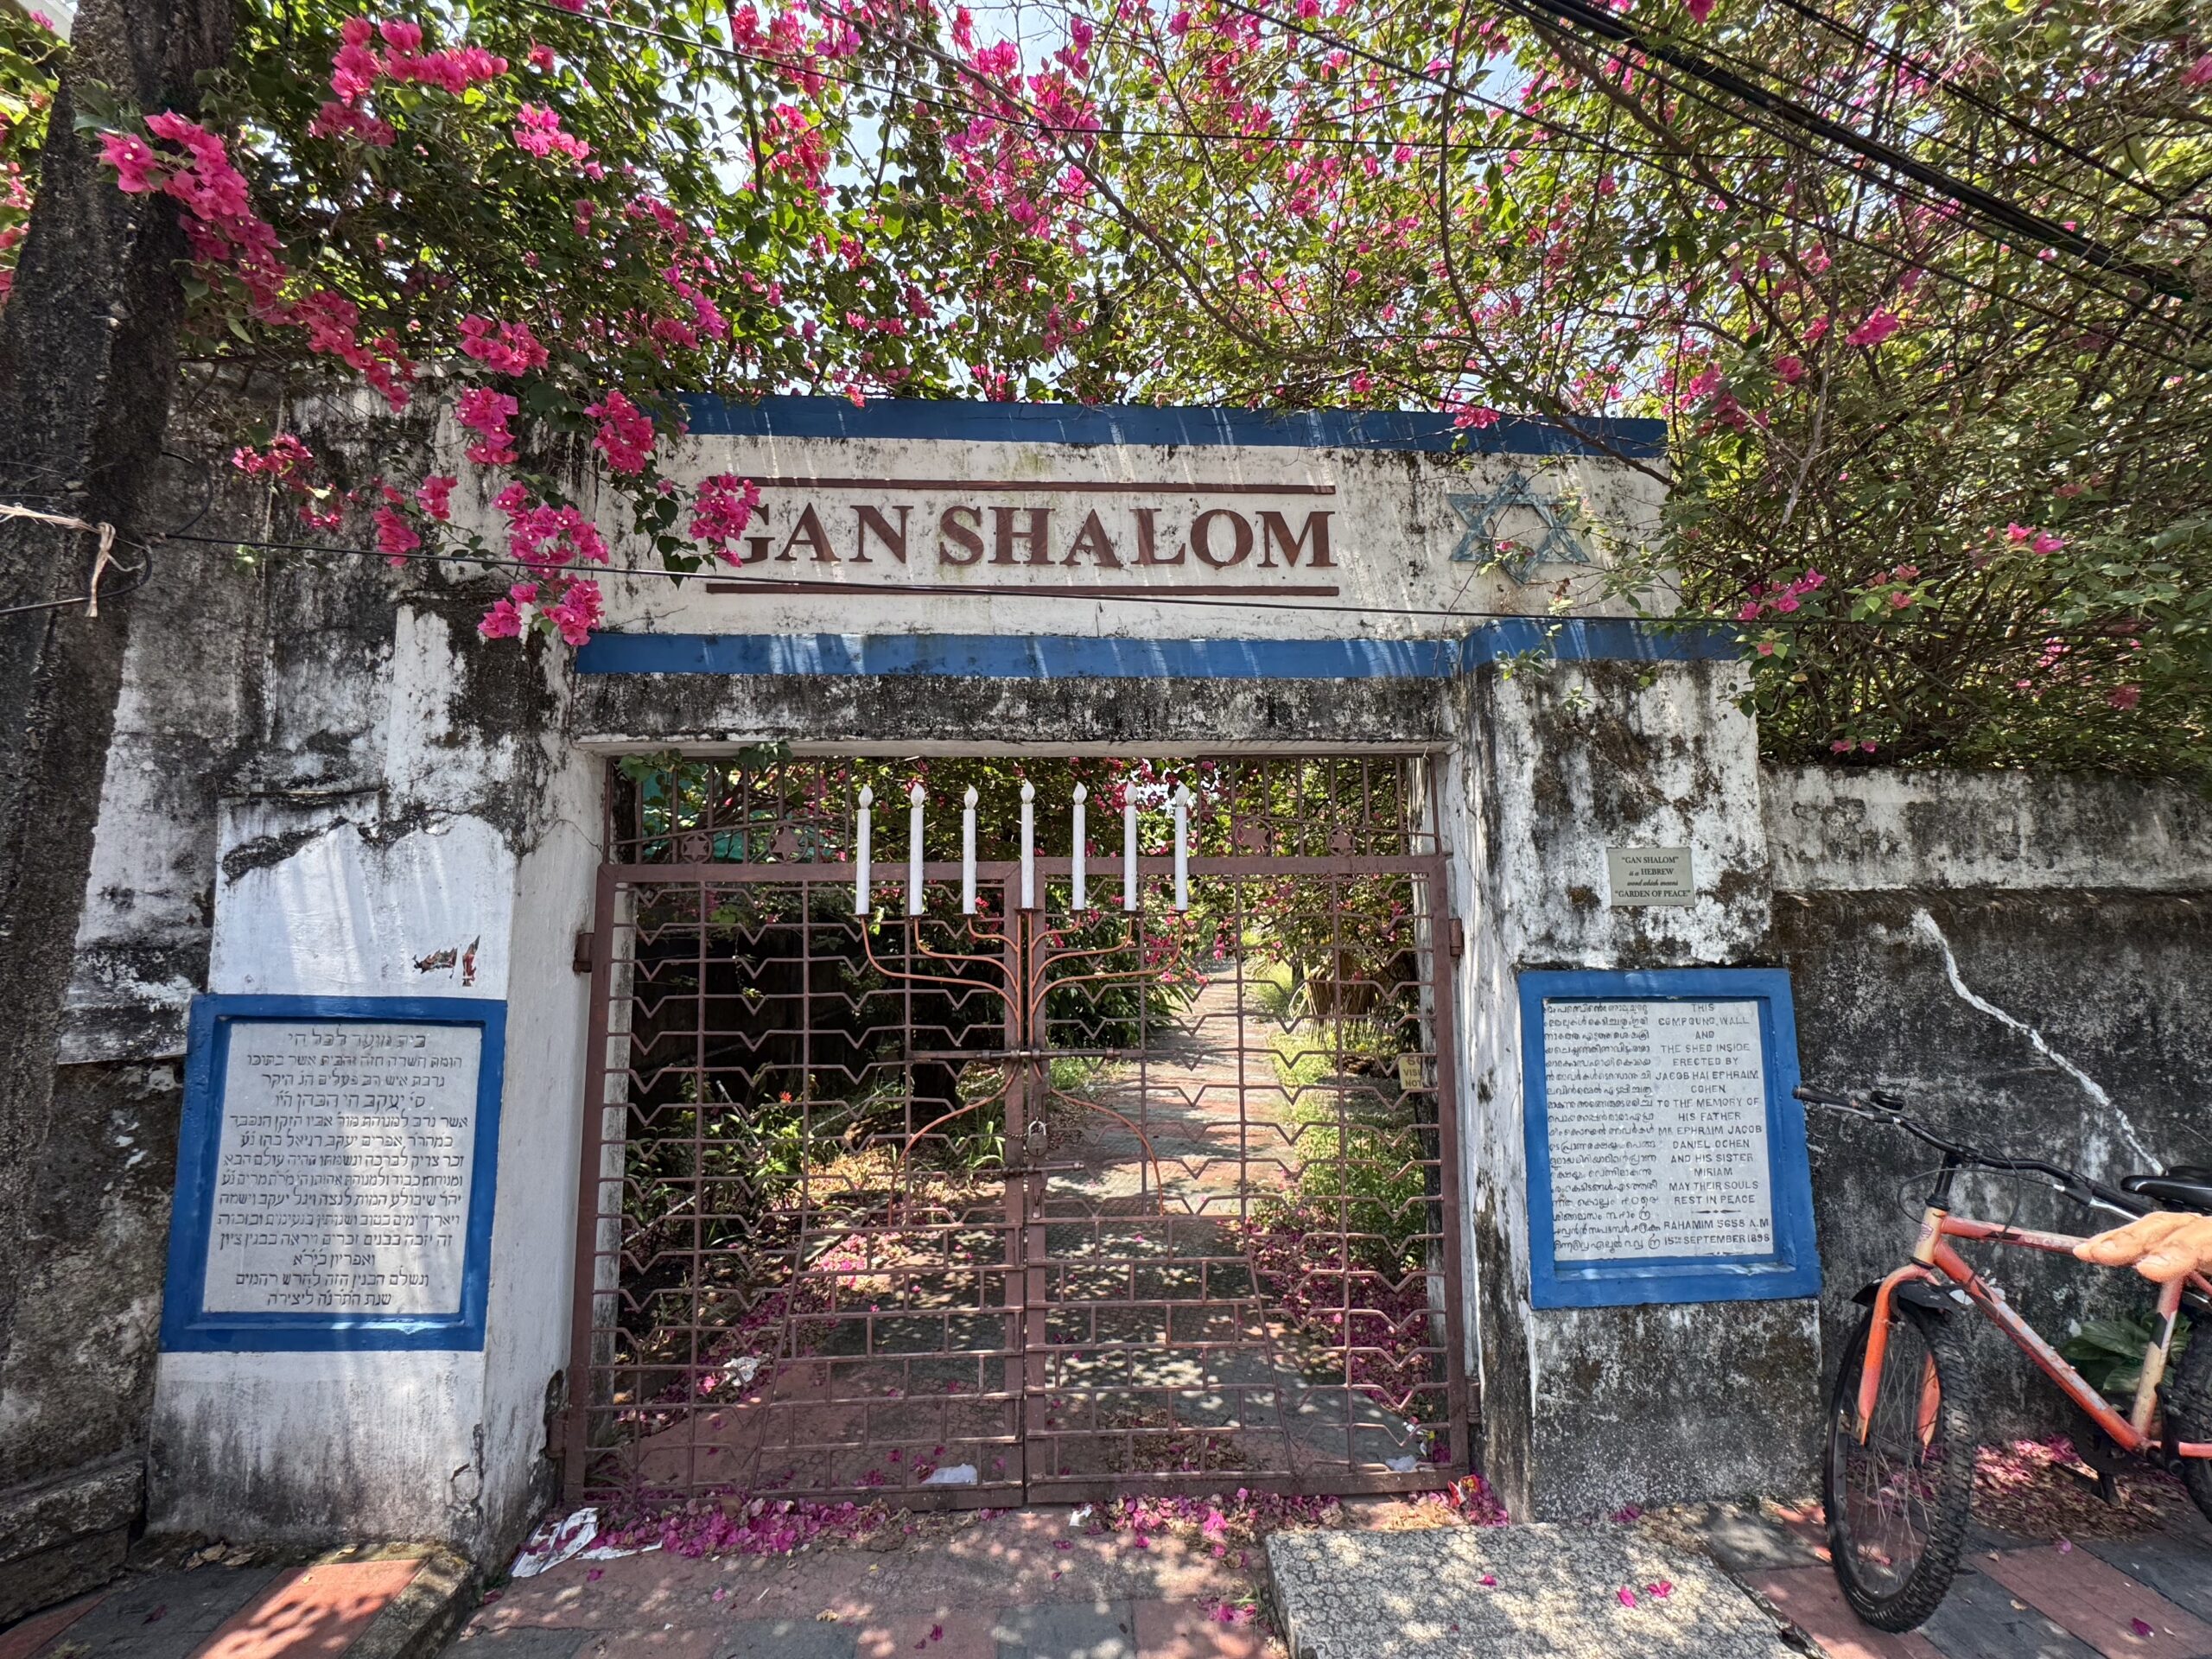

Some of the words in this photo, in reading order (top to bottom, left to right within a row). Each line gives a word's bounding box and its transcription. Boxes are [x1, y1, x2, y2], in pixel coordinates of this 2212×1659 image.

[718, 502, 914, 565] GAN
[938, 505, 1339, 569] SHALOM
[1692, 1003, 1714, 1012] THIS
[1719, 1016, 1751, 1025] WALL
[312, 1027, 346, 1046] לכל
[1695, 1031, 1714, 1039] AND
[1661, 1045, 1681, 1053] THE
[1686, 1044, 1713, 1053] SHED
[1716, 1043, 1751, 1052] INSIDE
[288, 1055, 316, 1066] אשר
[1673, 1057, 1721, 1066] ERECTED
[1726, 1057, 1738, 1065] BY
[1656, 1071, 1689, 1080] JACOB
[1692, 1071, 1708, 1080] HAI
[1712, 1070, 1759, 1080] EPHRAIM
[1691, 1084, 1726, 1093] COHEN
[362, 1093, 405, 1115] יעקב
[1657, 1099, 1669, 1108] TO
[1674, 1099, 1693, 1108] THE
[1696, 1097, 1742, 1107] MEMORY
[1746, 1097, 1759, 1106] OF
[440, 1116, 469, 1128] אשר
[1678, 1113, 1695, 1122] HIS
[1700, 1112, 1741, 1122] FATHER
[1677, 1127, 1724, 1135] EPHRAIM
[1727, 1125, 1762, 1134] JACOB
[1673, 1140, 1711, 1149] DANIEL
[254, 1147, 285, 1167] עולם
[1671, 1154, 1691, 1163] AND
[1695, 1154, 1713, 1163] HIS
[1716, 1153, 1753, 1162] SISTER
[1694, 1167, 1732, 1177] MIRIAM
[1669, 1182, 1690, 1191] MAY
[1694, 1182, 1722, 1191] THEIR
[1724, 1180, 1759, 1190] SOULS
[1675, 1196, 1702, 1205] REST
[1707, 1195, 1717, 1205] IN
[1720, 1195, 1756, 1204] PEACE
[1663, 1220, 1713, 1230] RAHAMIM
[1717, 1219, 1745, 1228] 5658
[436, 1235, 453, 1247] זה
[1683, 1235, 1745, 1244] SEPTEMBER
[1747, 1233, 1770, 1243] 1898
[364, 1294, 391, 1306] שנת
